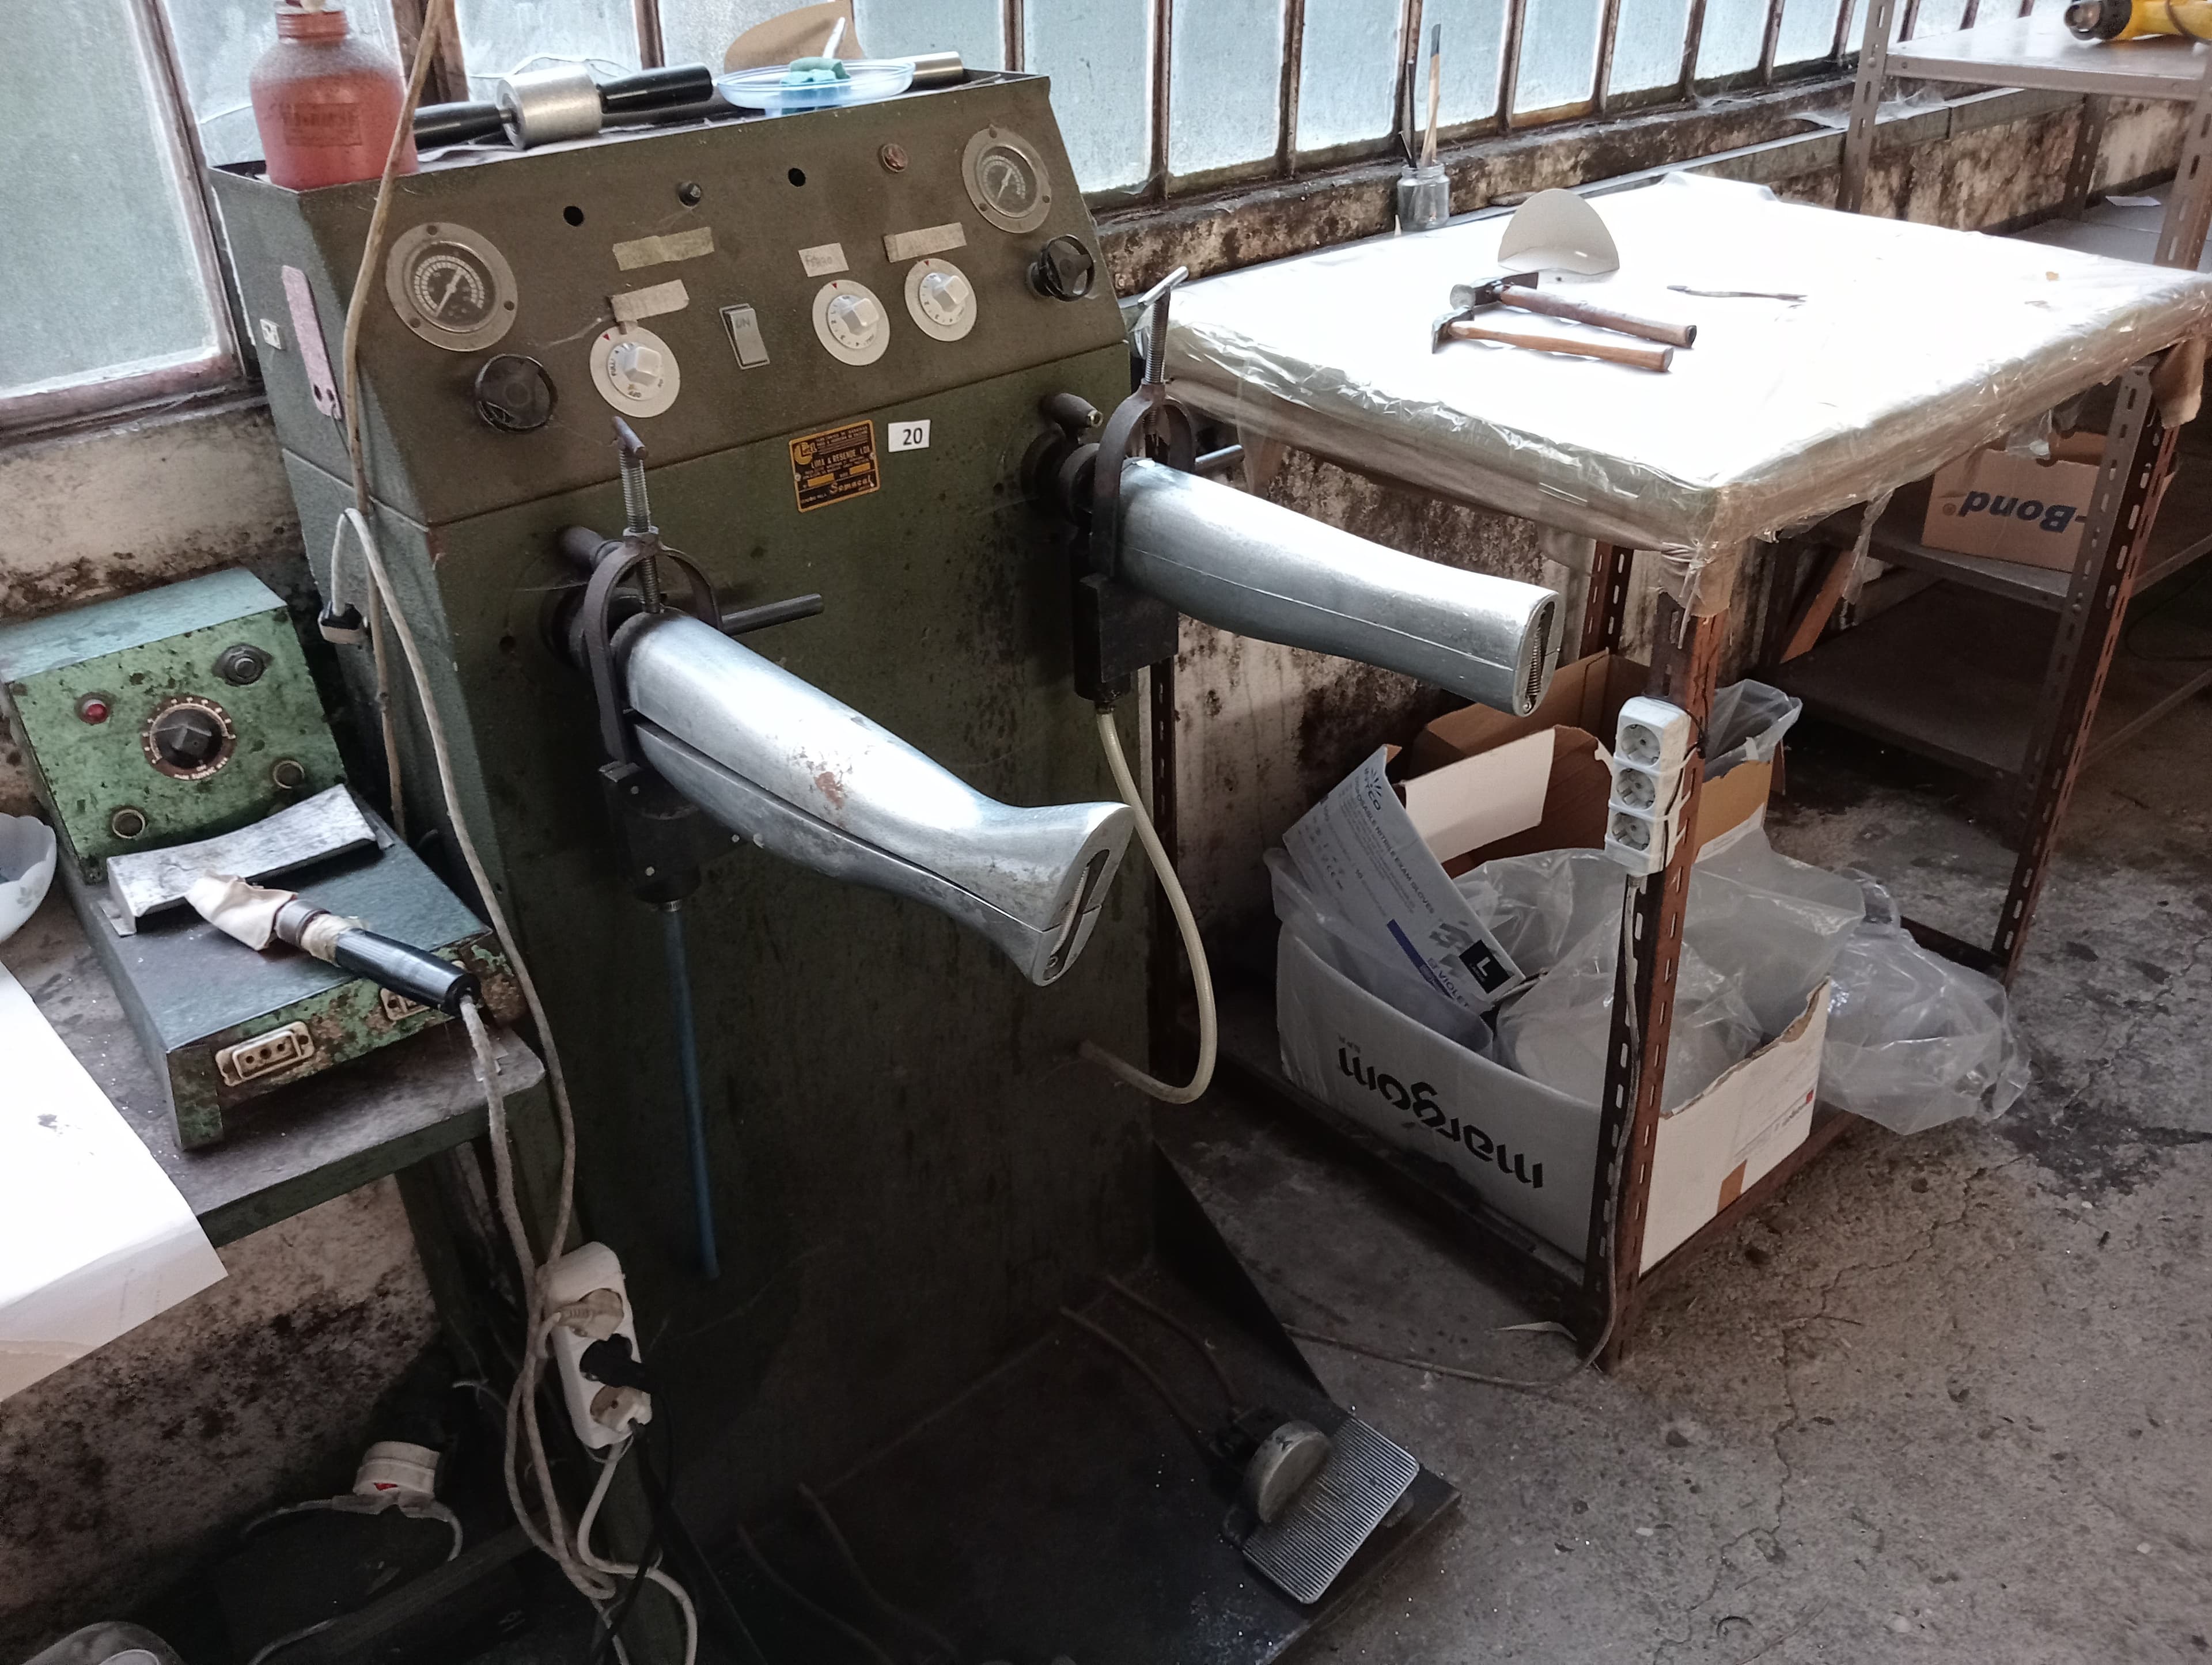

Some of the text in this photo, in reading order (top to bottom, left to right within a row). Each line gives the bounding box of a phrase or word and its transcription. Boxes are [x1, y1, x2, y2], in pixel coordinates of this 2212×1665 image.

[902, 427, 923, 446] 20
[1957, 490, 2077, 533] Bond
[1395, 857, 1411, 881] EXAM
[1410, 882, 1435, 914] GLOVES
[1476, 956, 1491, 977] L
[1438, 970, 1469, 1008] VIOLET
[1338, 1047, 1544, 1189] margom
